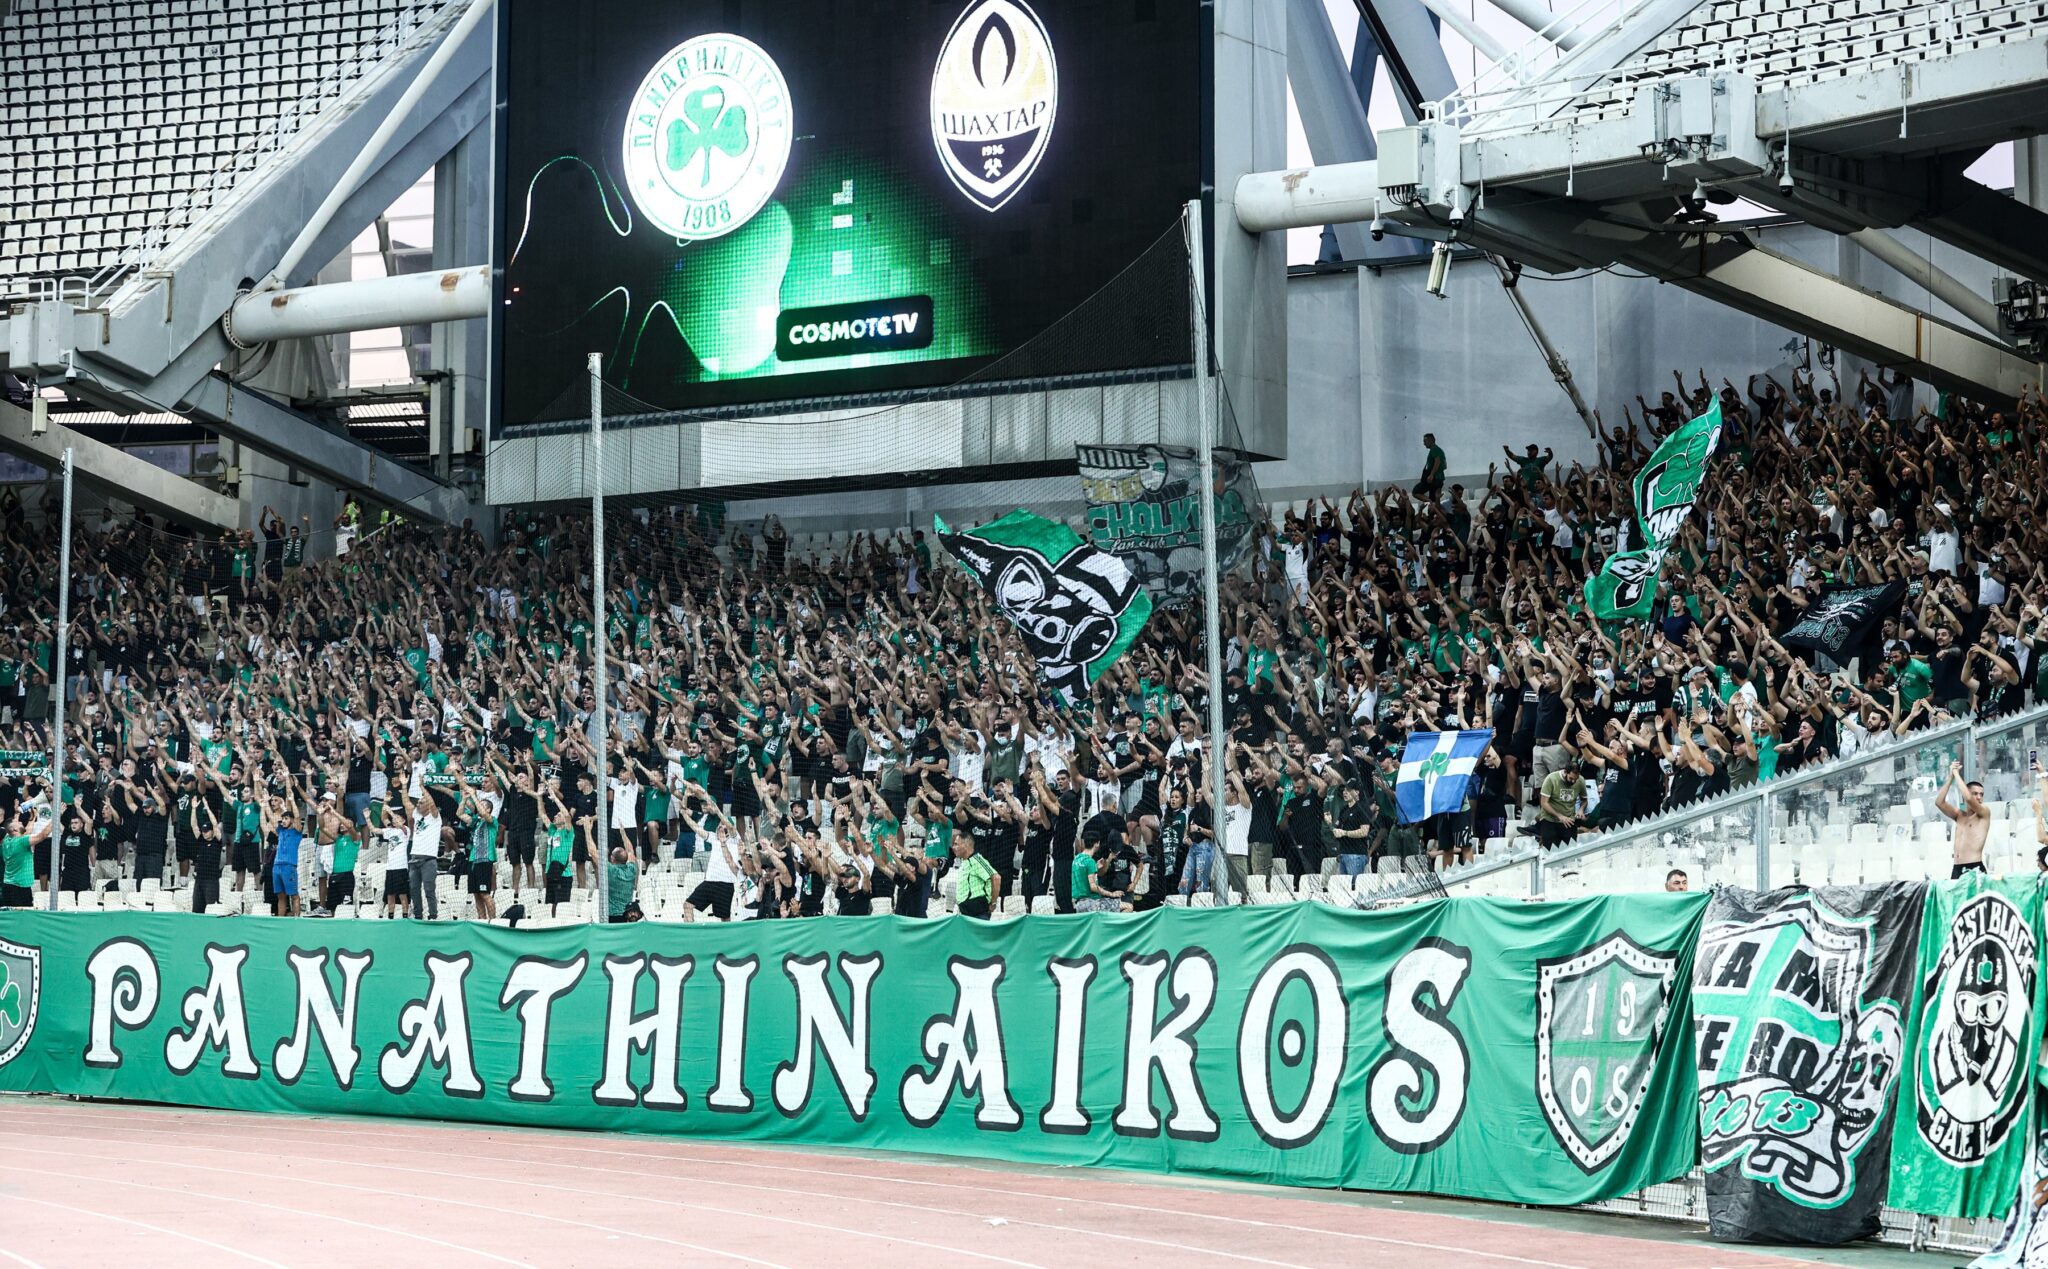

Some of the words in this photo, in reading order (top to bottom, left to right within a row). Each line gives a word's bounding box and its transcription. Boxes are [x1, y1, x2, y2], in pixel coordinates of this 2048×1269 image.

[942, 101, 1047, 136] ШАХТАР
[682, 199, 732, 231] 1908
[891, 311, 919, 336] TV
[84, 936, 1473, 1156] PANATHINAIKOS
